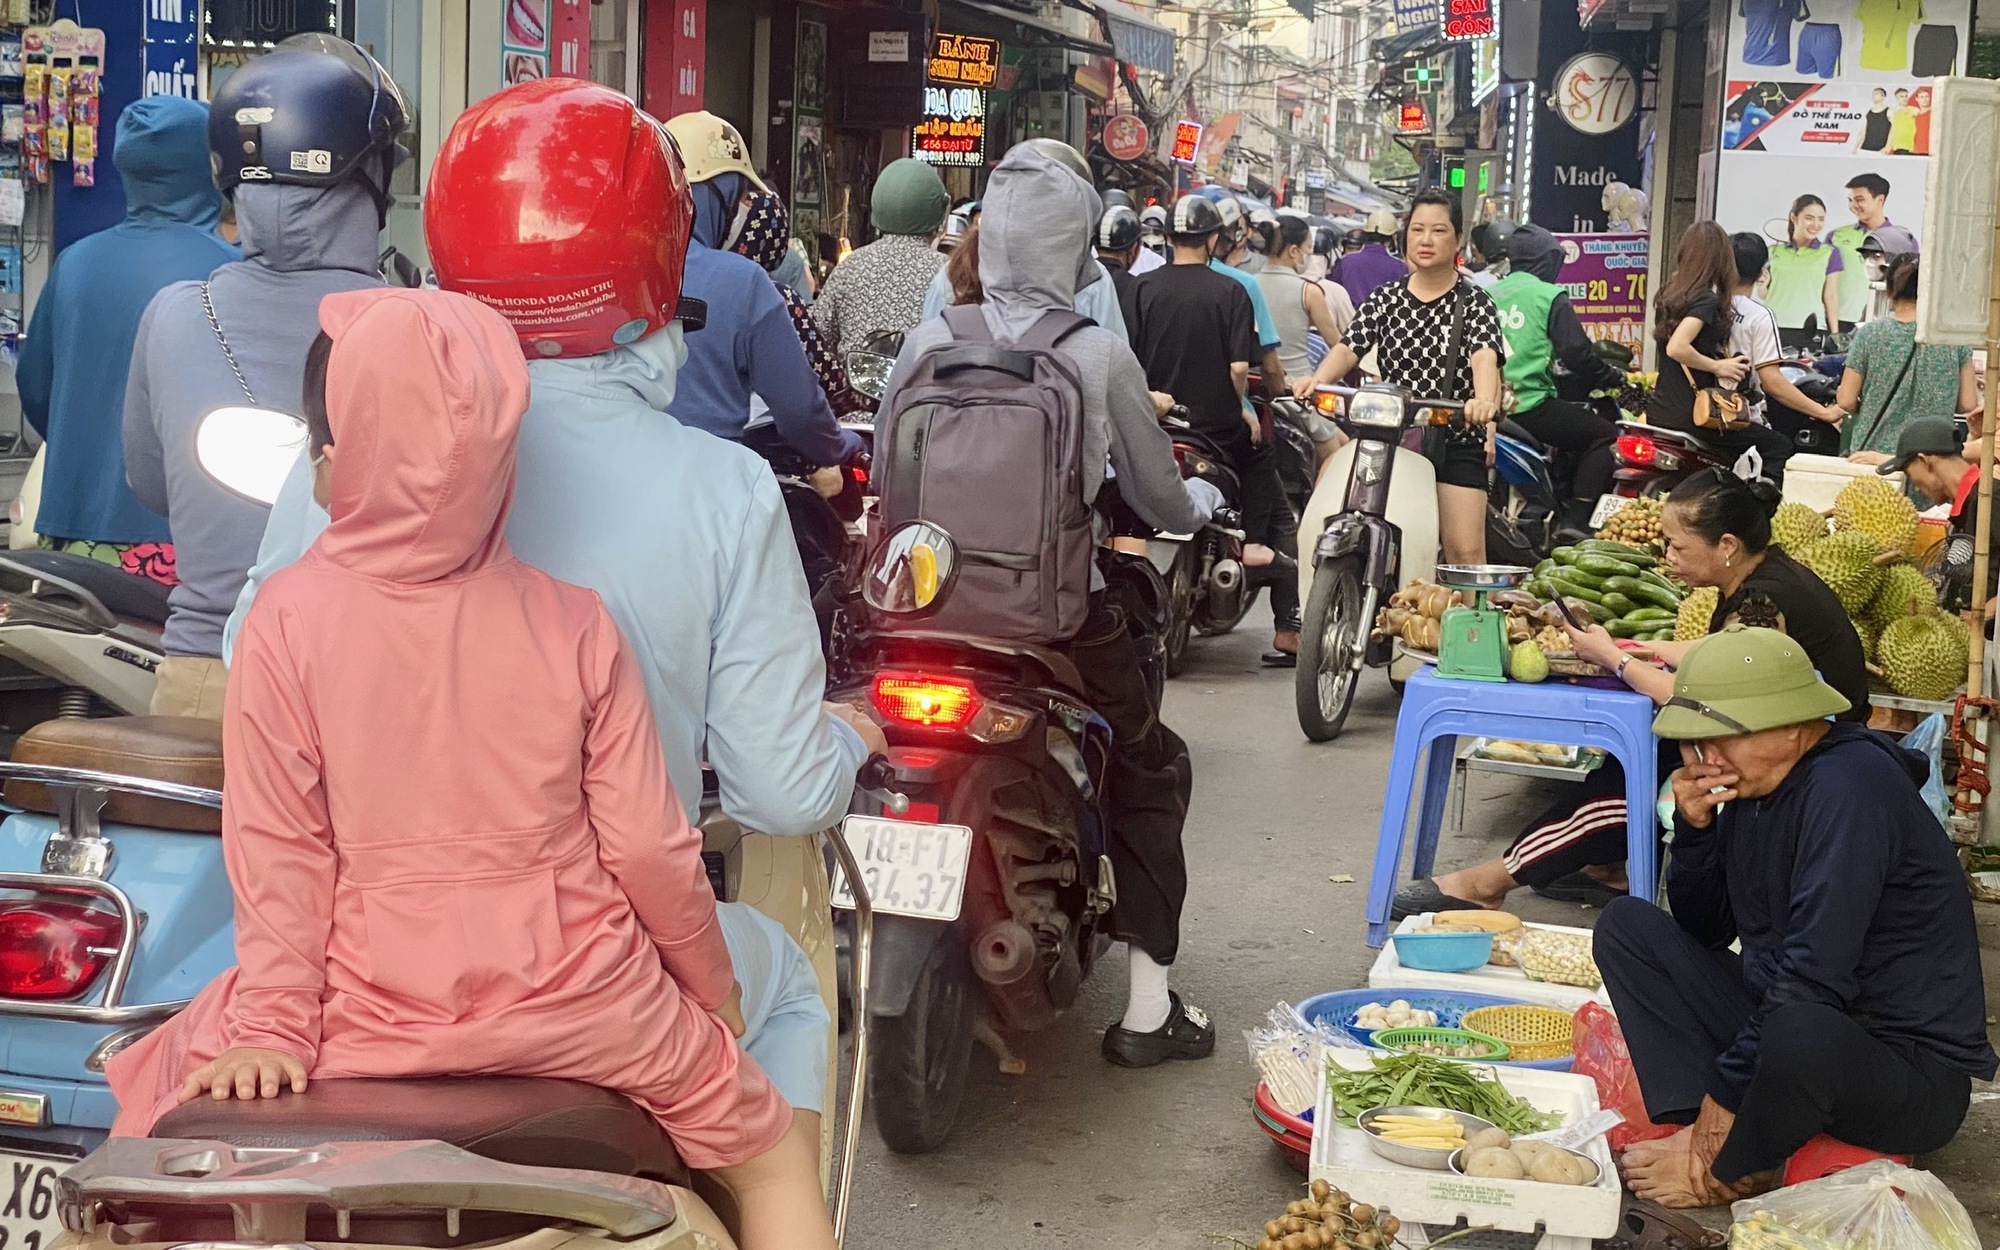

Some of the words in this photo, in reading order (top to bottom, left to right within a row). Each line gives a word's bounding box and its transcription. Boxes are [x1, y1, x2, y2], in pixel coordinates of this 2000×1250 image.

[1447, 15, 1493, 36] GÒN
[1814, 122, 1839, 130] NAM
[1832, 112, 1862, 121] THAO
[1553, 165, 1617, 186] Made
[1573, 214, 1595, 233] in
[505, 297, 546, 307] HONDA
[548, 288, 590, 304] DOANH
[591, 279, 614, 295] THU
[1588, 280, 1607, 301] 20
